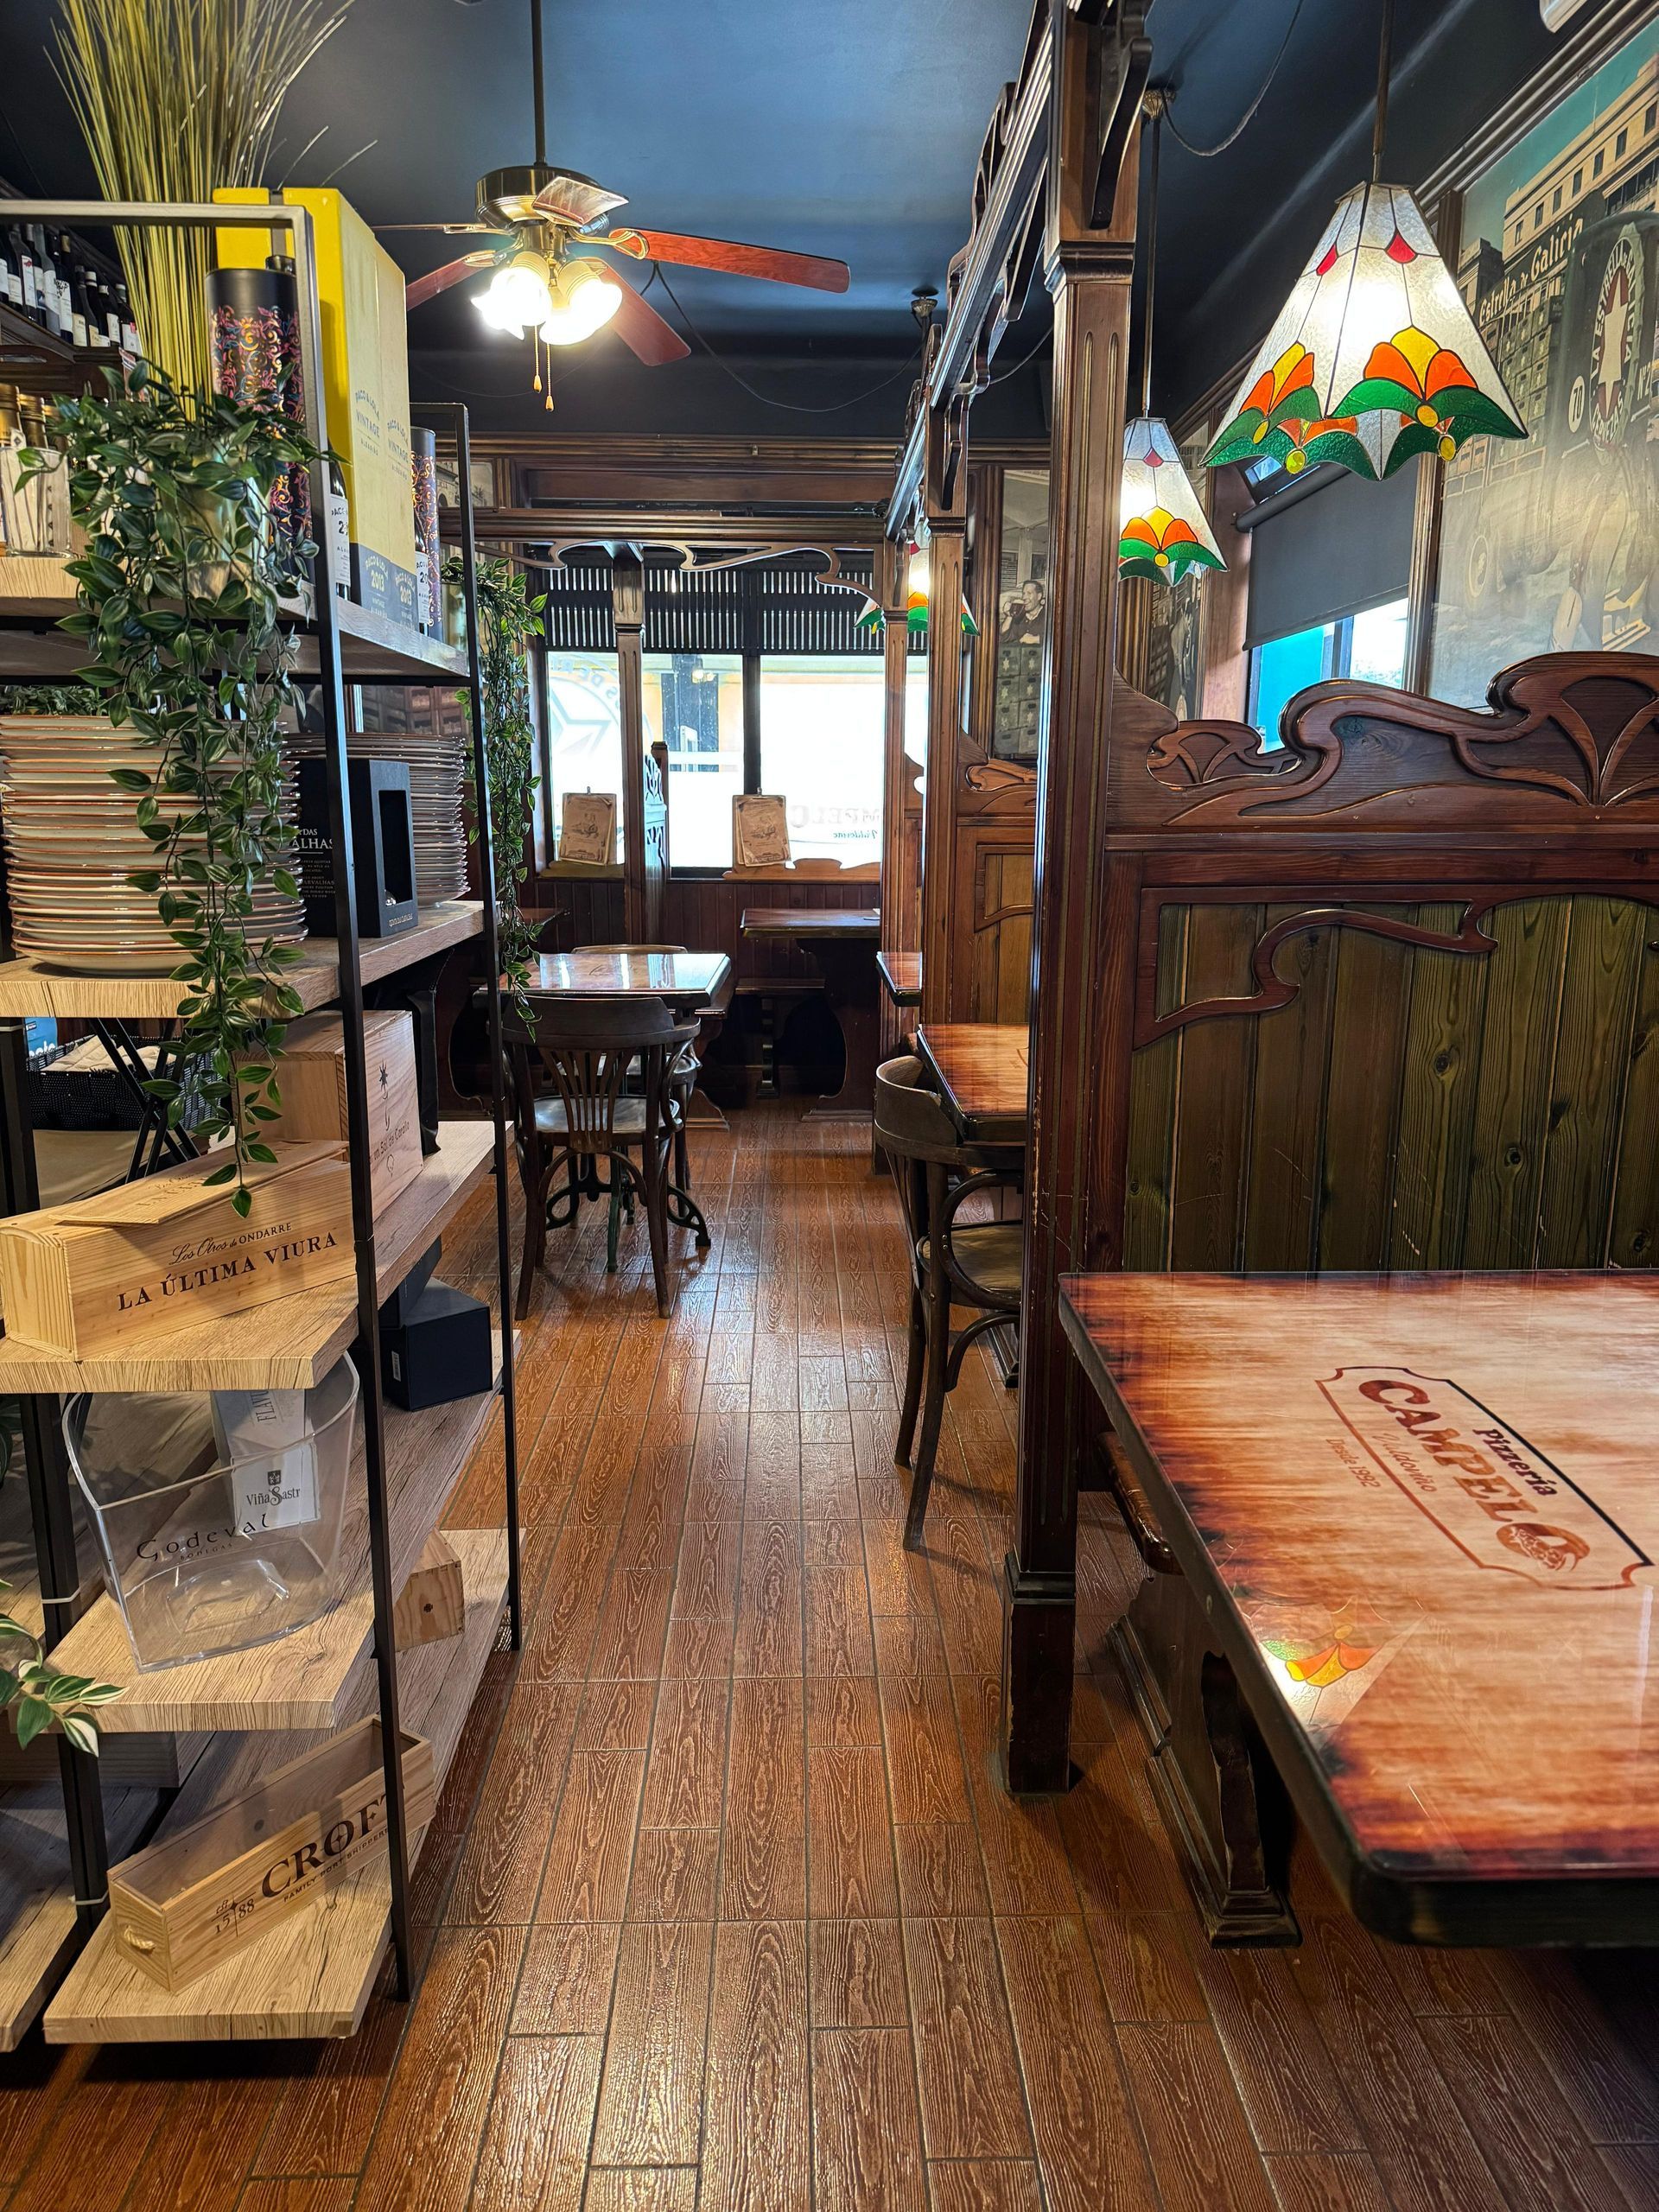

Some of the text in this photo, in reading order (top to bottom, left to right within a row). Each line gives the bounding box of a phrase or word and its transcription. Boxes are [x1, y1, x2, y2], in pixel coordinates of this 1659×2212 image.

[1479, 276, 1516, 324] Estrella
[1531, 218, 1583, 281] Galicia
[1624, 249, 1636, 363] GALICIA
[356, 410, 380, 438] VINTAGE
[1572, 388, 1584, 422] 70
[388, 437, 409, 464] VINTAGE
[371, 571, 385, 593] 2013
[400, 585, 411, 607] 2013
[168, 1243, 194, 1265] Los
[238, 1223, 292, 1245] ONDARRE
[118, 1231, 339, 1312] LA ÚLTIMA VIURA
[1325, 1438, 1382, 1488] Desde 1992
[1358, 1379, 1591, 1571] CAMPELO
[1472, 1428, 1558, 1497] Pizzería
[246, 1491, 270, 1507] Viña
[137, 1513, 270, 1562] Godeval
[283, 1876, 316, 1903] FAMILY
[321, 1858, 345, 1878] PORT
